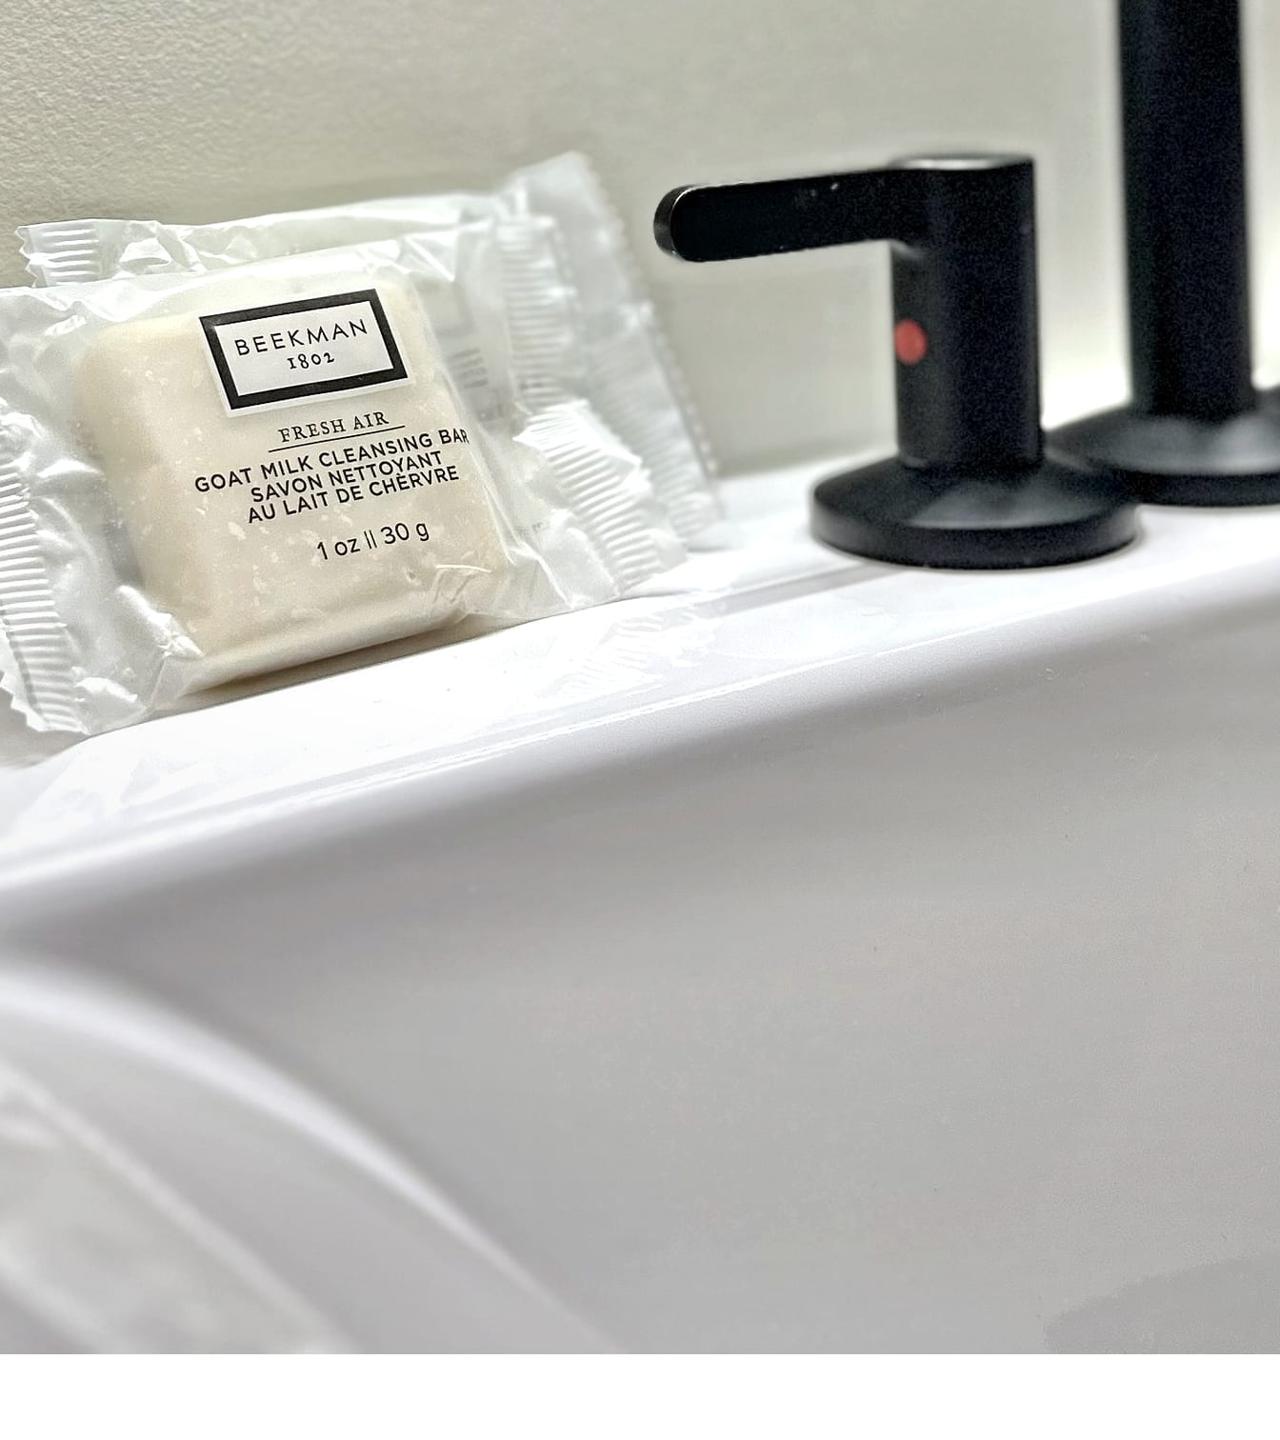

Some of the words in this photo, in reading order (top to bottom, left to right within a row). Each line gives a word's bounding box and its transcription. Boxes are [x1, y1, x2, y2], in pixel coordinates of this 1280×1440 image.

[234, 318, 368, 356] BEEKMAN
[286, 351, 336, 370] 1802
[278, 418, 346, 443] FRESH
[353, 411, 389, 431] AIR
[194, 468, 252, 493] GOAT
[260, 455, 313, 482] MILK
[319, 432, 433, 468] CLEANSING
[438, 427, 470, 445] BAR
[250, 473, 323, 503] SAVON
[328, 450, 441, 488] NETTOYANT
[248, 503, 276, 524] AU
[282, 491, 329, 516] LAIT
[336, 485, 364, 504] DE
[369, 465, 460, 496] CHÈRVRE
[316, 541, 329, 560] 1
[334, 537, 361, 556] oz
[380, 522, 410, 545] 30
[415, 522, 430, 542] g
